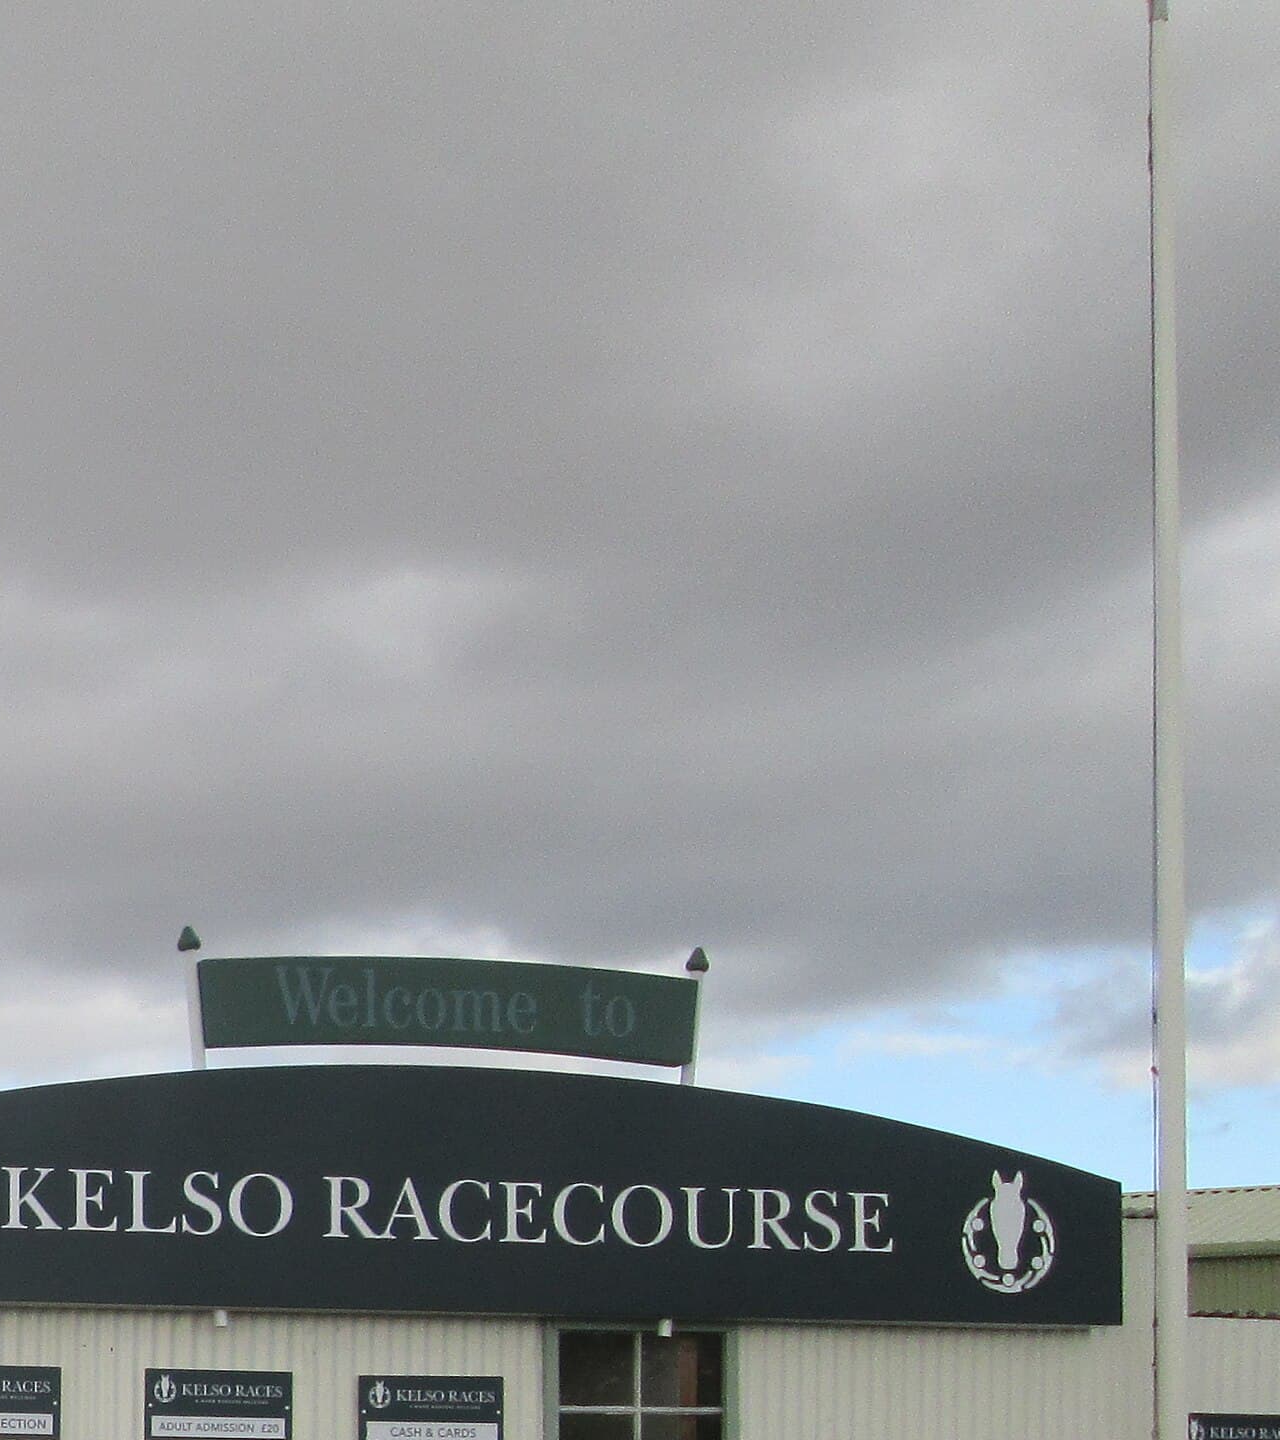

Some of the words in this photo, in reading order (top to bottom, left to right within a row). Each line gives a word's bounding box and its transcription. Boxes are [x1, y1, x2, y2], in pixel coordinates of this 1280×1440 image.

[276, 965, 538, 1034] Welcome
[579, 979, 637, 1038] to
[1, 1166, 294, 1238] KELSO
[323, 1175, 895, 1253] RACECOURSE
[2, 1379, 51, 1394] RACES
[182, 1383, 231, 1396] KELSO
[235, 1385, 283, 1398] RACES
[396, 1389, 445, 1402] KELSO
[449, 1391, 496, 1404] RACES
[159, 1422, 192, 1432] ADULT
[196, 1422, 254, 1433] ADMISSION
[261, 1423, 279, 1434] £20
[390, 1426, 422, 1438] CASH
[425, 1427, 433, 1438] &
[438, 1427, 477, 1438] CARDS
[1210, 1426, 1256, 1440] KELSO
[1259, 1427, 1280, 1440] RA
